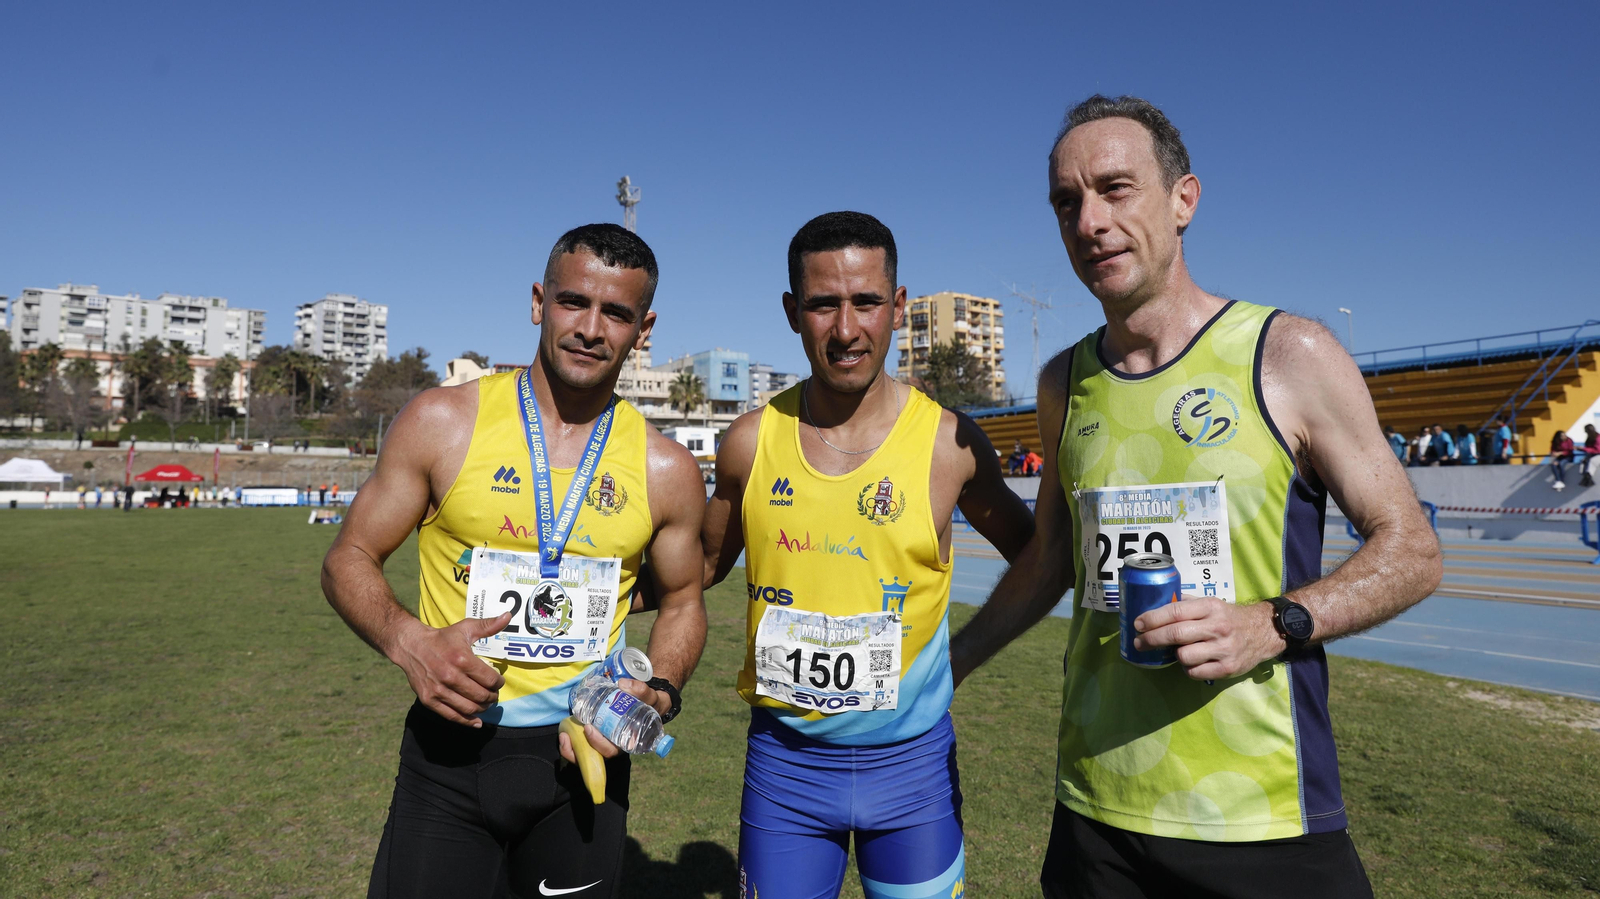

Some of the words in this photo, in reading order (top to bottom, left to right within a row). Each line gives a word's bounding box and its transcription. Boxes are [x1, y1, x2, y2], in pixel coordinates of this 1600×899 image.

[524, 399, 537, 422] CIUDAD
[1174, 390, 1196, 436] ALGECIRAS
[1216, 392, 1240, 419] ATLETISMO
[530, 424, 540, 432] DE
[594, 410, 612, 442] ALGECIRAS
[1078, 422, 1099, 436] AMURA
[590, 441, 600, 451] DE
[1196, 428, 1238, 448] INMACULADA
[531, 434, 546, 473] ALGECIRAS
[580, 450, 596, 475] CIUDAD
[490, 485, 520, 494] mobel
[538, 480, 548, 488] 19
[566, 475, 588, 510] MARATÓN
[540, 491, 551, 520] MARZO
[1128, 493, 1152, 501] MEDIA
[1100, 498, 1172, 518] MARATÓN
[556, 510, 574, 532] MEDIA
[1136, 516, 1174, 524] ALGECIRAS
[776, 528, 869, 561] Andalucía
[516, 564, 580, 580] MAÓN
[1202, 568, 1211, 580] S
[590, 627, 598, 636] M
[504, 642, 575, 658] EVOS
[786, 648, 855, 690] 150
[876, 680, 883, 688] M
[792, 692, 860, 709] EVOS
